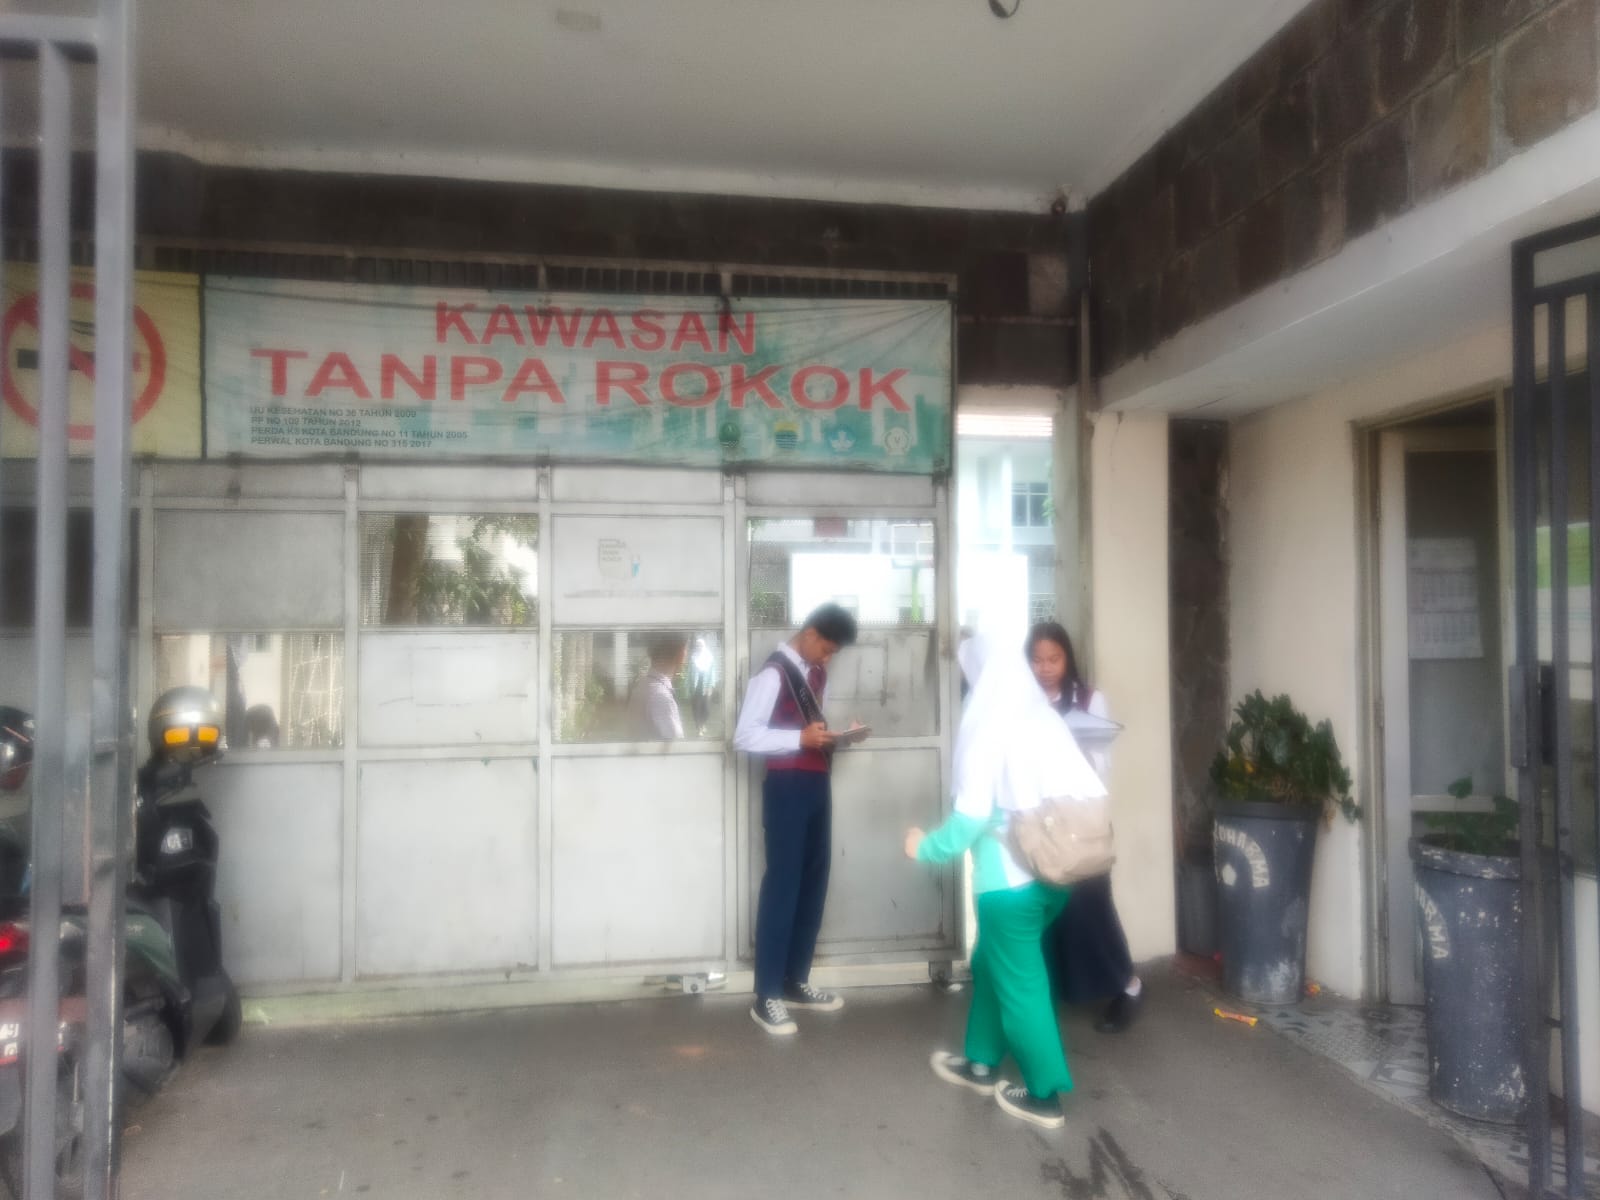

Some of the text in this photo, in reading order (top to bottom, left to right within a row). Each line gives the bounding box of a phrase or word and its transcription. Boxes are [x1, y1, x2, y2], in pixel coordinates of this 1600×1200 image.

[435, 301, 756, 355] KAWASAN
[250, 347, 912, 412] TANPA ROKOK
[267, 407, 327, 416] KESEHATAN
[329, 408, 344, 417] NO
[359, 408, 392, 418] TAHUN
[266, 416, 281, 425] NO
[303, 417, 337, 426] TAHUN
[251, 426, 285, 435] PERDA
[302, 428, 328, 437] KOTA
[330, 429, 379, 438] BANDUNG
[381, 430, 397, 439] NO
[411, 431, 444, 440] TAHUN
[445, 431, 468, 440] 2005
[251, 437, 292, 446] PERWAL
[295, 438, 322, 447] KOTA
[323, 438, 373, 448] BANDUNG
[374, 439, 390, 448] NO
